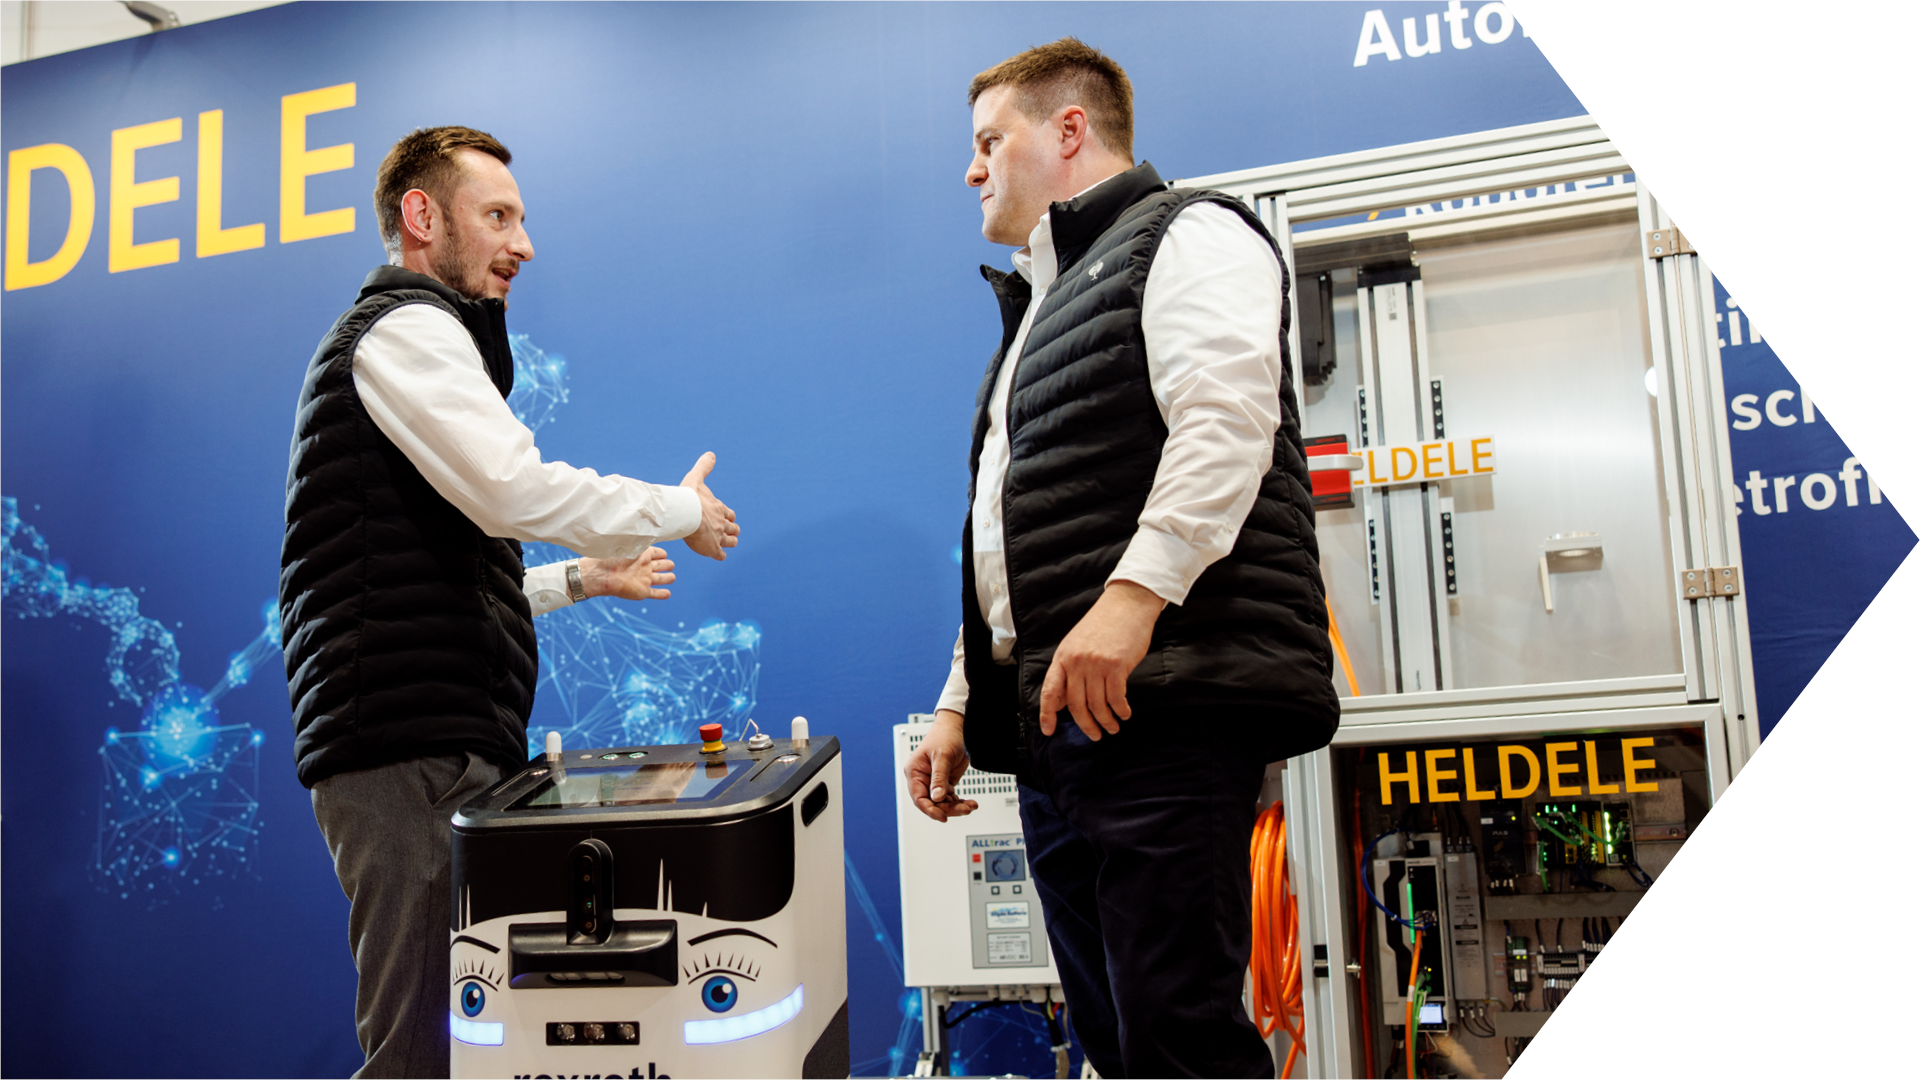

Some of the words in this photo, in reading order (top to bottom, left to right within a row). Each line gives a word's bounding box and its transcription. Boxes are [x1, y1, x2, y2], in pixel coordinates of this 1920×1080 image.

[1353, 0, 1531, 68] Auto
[4, 82, 356, 291] DELE
[1377, 736, 1659, 806] HELDELE
